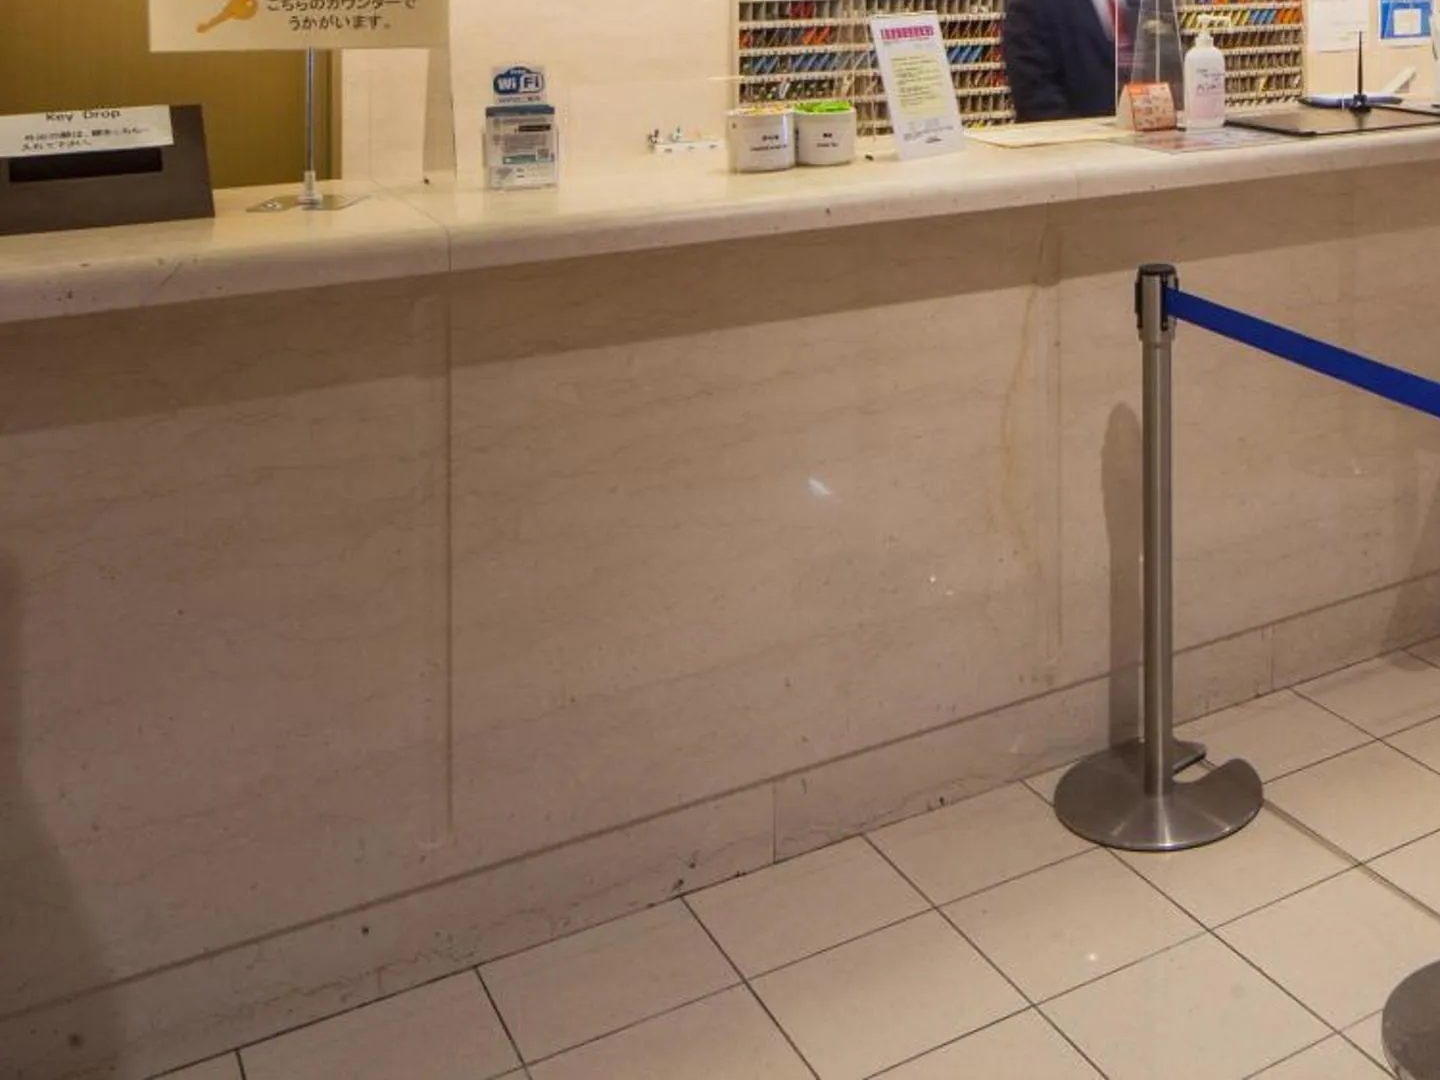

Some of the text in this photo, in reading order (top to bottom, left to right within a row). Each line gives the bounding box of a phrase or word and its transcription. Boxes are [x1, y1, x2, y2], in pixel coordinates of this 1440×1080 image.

[289, 15, 392, 31] うかがいます。
[46, 110, 121, 122] Key Drop
